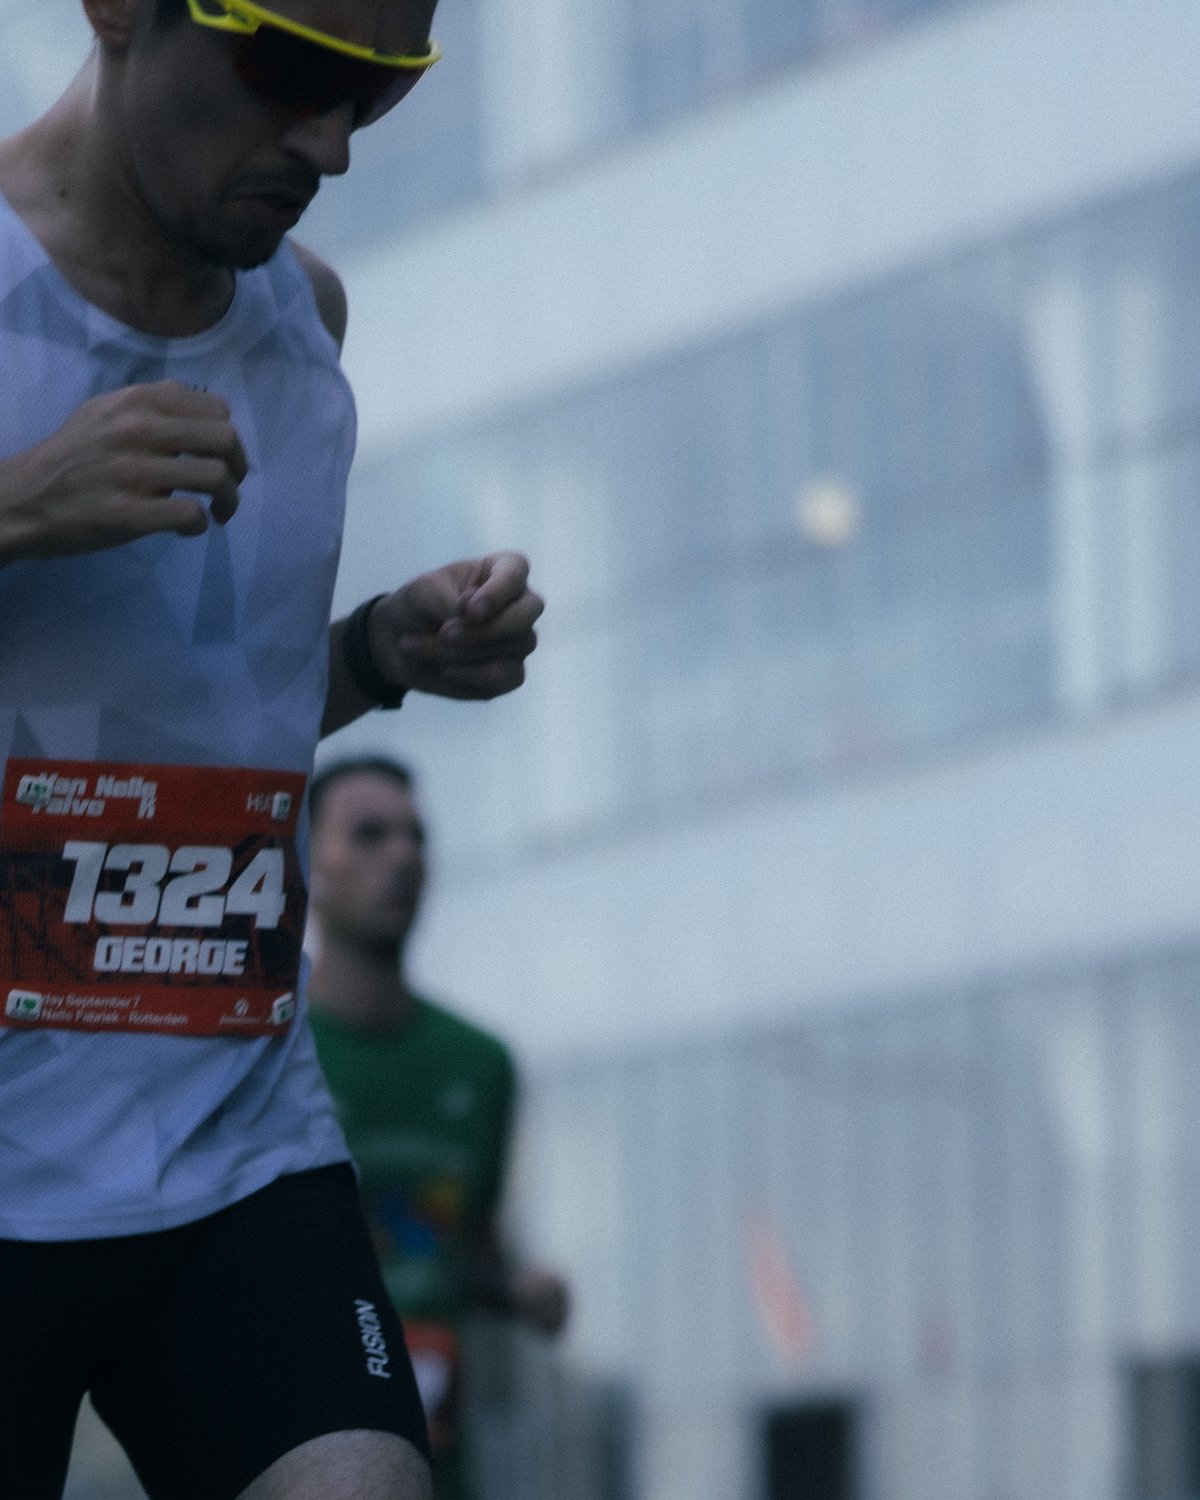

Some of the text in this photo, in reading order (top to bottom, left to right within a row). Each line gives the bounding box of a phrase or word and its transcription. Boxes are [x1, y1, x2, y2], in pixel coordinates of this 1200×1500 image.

[95, 775, 157, 799] Nelle
[62, 841, 286, 929] 1324
[94, 936, 249, 976] GEORGE
[352, 1298, 392, 1378] FUSION
